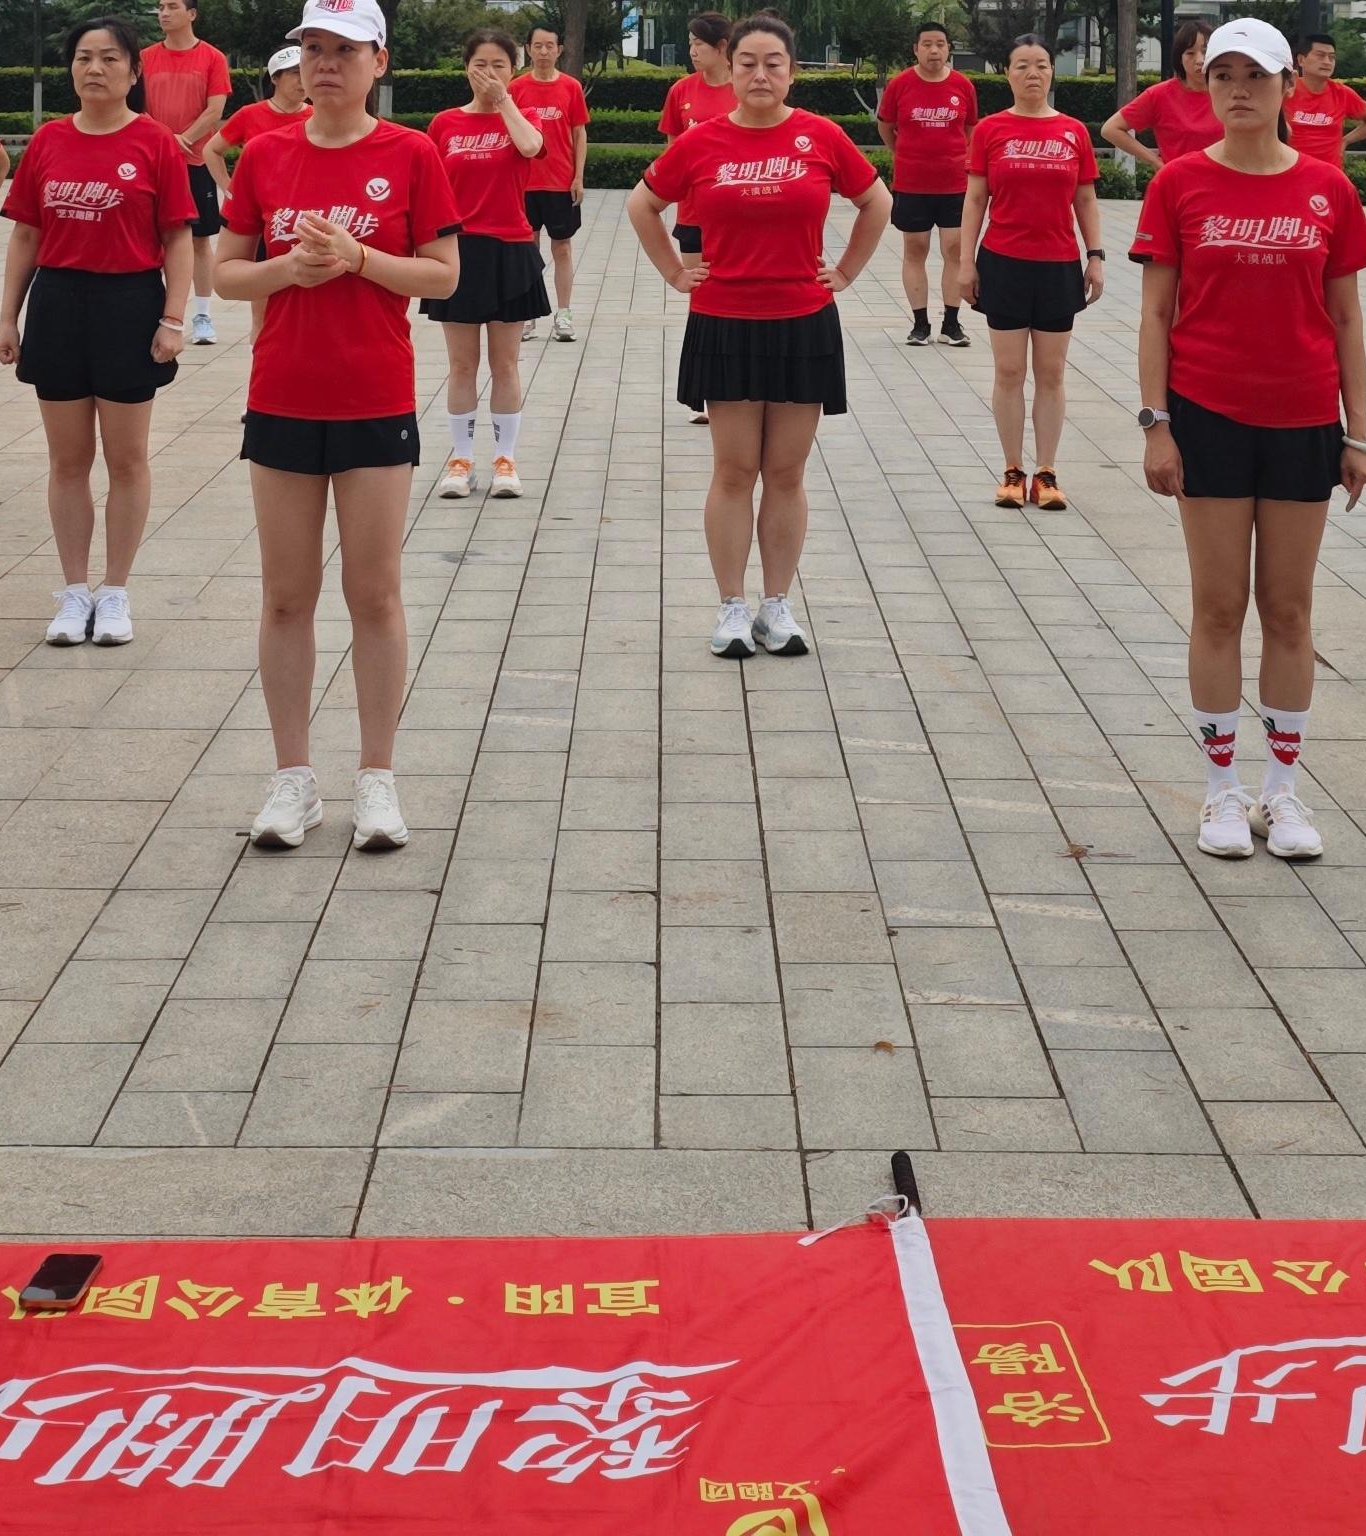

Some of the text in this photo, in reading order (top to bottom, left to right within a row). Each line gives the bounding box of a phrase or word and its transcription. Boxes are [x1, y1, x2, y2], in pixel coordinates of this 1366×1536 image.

[711, 156, 809, 189] 黎明脚步
[1195, 215, 1322, 249] 黎明脚步
[699, 1478, 815, 1503] 文跑团
